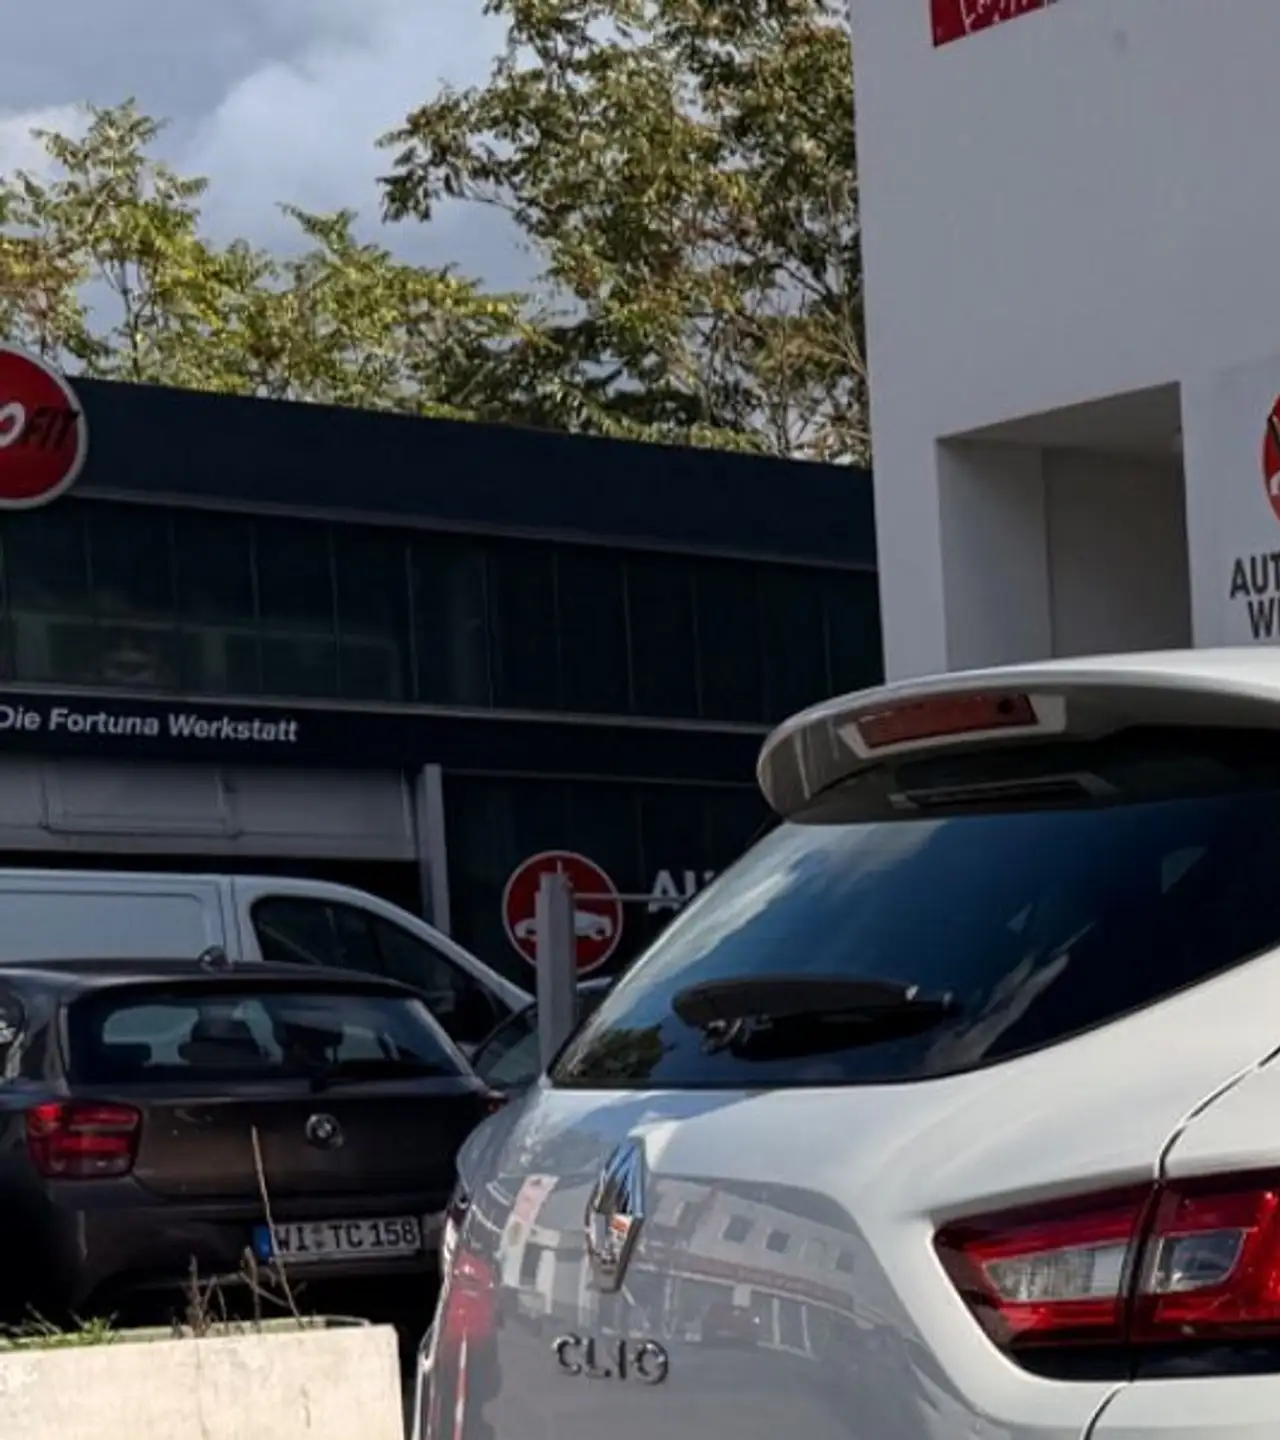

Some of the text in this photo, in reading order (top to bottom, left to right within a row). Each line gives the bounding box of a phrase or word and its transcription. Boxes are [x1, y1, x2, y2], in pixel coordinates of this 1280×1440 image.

[0, 705, 299, 742] Die Fortuna Werkstatt
[327, 1221, 363, 1249] TC
[369, 1218, 416, 1248] 158
[552, 1332, 669, 1386] CLIO
